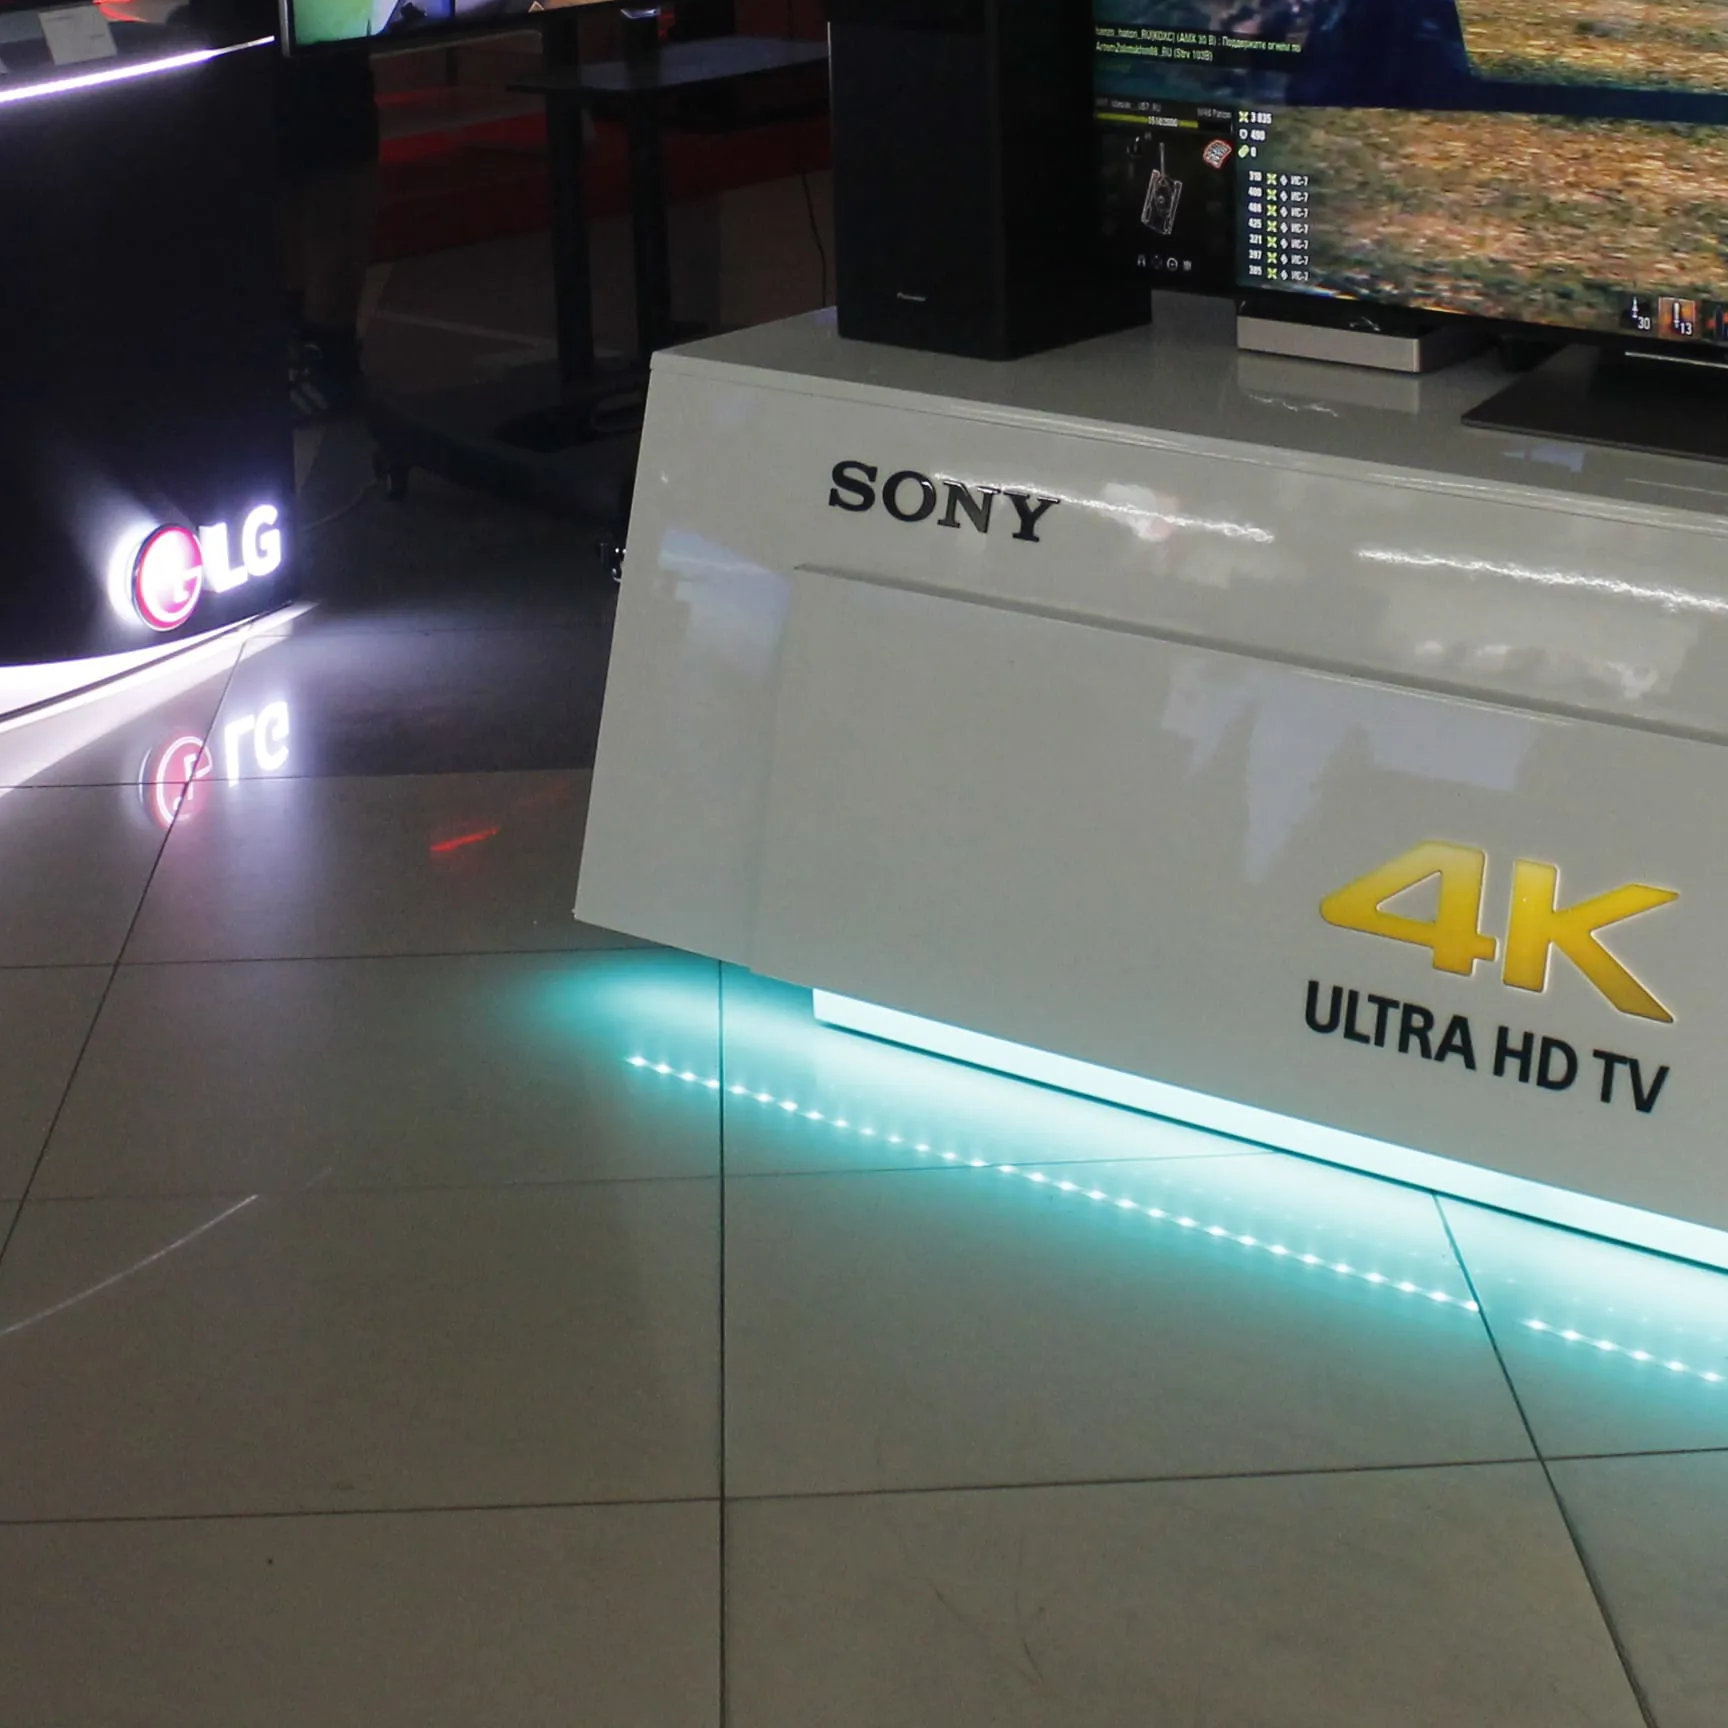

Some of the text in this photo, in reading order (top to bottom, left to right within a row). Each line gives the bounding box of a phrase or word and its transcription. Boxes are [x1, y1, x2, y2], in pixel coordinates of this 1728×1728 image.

[1637, 317, 1652, 331] 30
[1680, 322, 1694, 337] 13
[824, 458, 1063, 548] SONY
[1317, 838, 1684, 1028] 4K
[1300, 977, 1672, 1118] ULTRA HD TV
